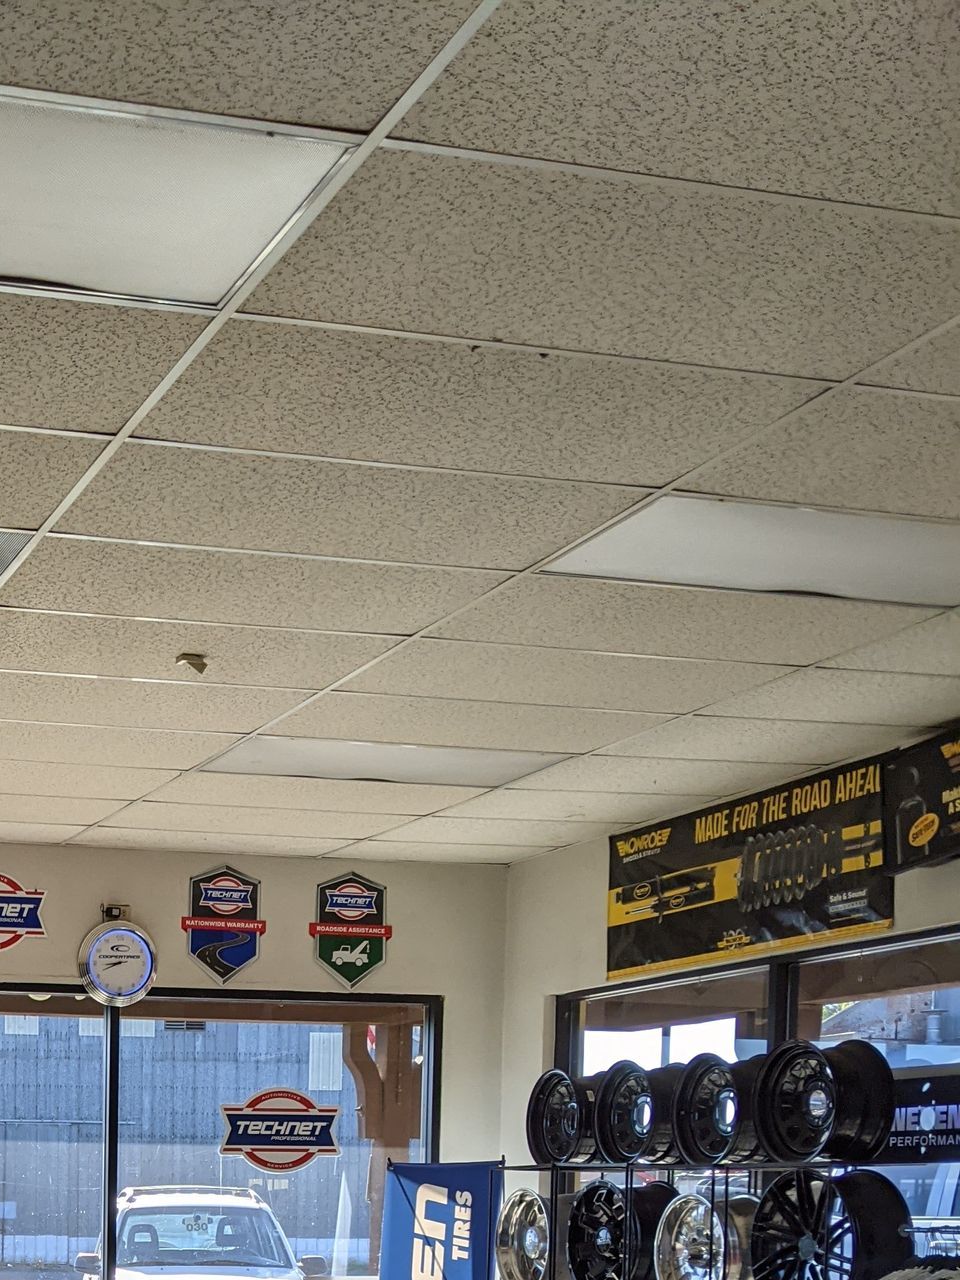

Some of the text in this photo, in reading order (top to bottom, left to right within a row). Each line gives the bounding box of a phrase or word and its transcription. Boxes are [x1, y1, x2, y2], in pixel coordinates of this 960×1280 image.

[695, 809, 730, 844] MADE
[732, 801, 759, 833] FOR
[762, 792, 789, 824] THE
[791, 779, 831, 816] ROAD
[617, 828, 672, 857] MONROE
[226, 921, 262, 929] WARRANTY
[261, 1092, 301, 1100] AUTOMOTIVE
[452, 1190, 473, 1261] TIRES
